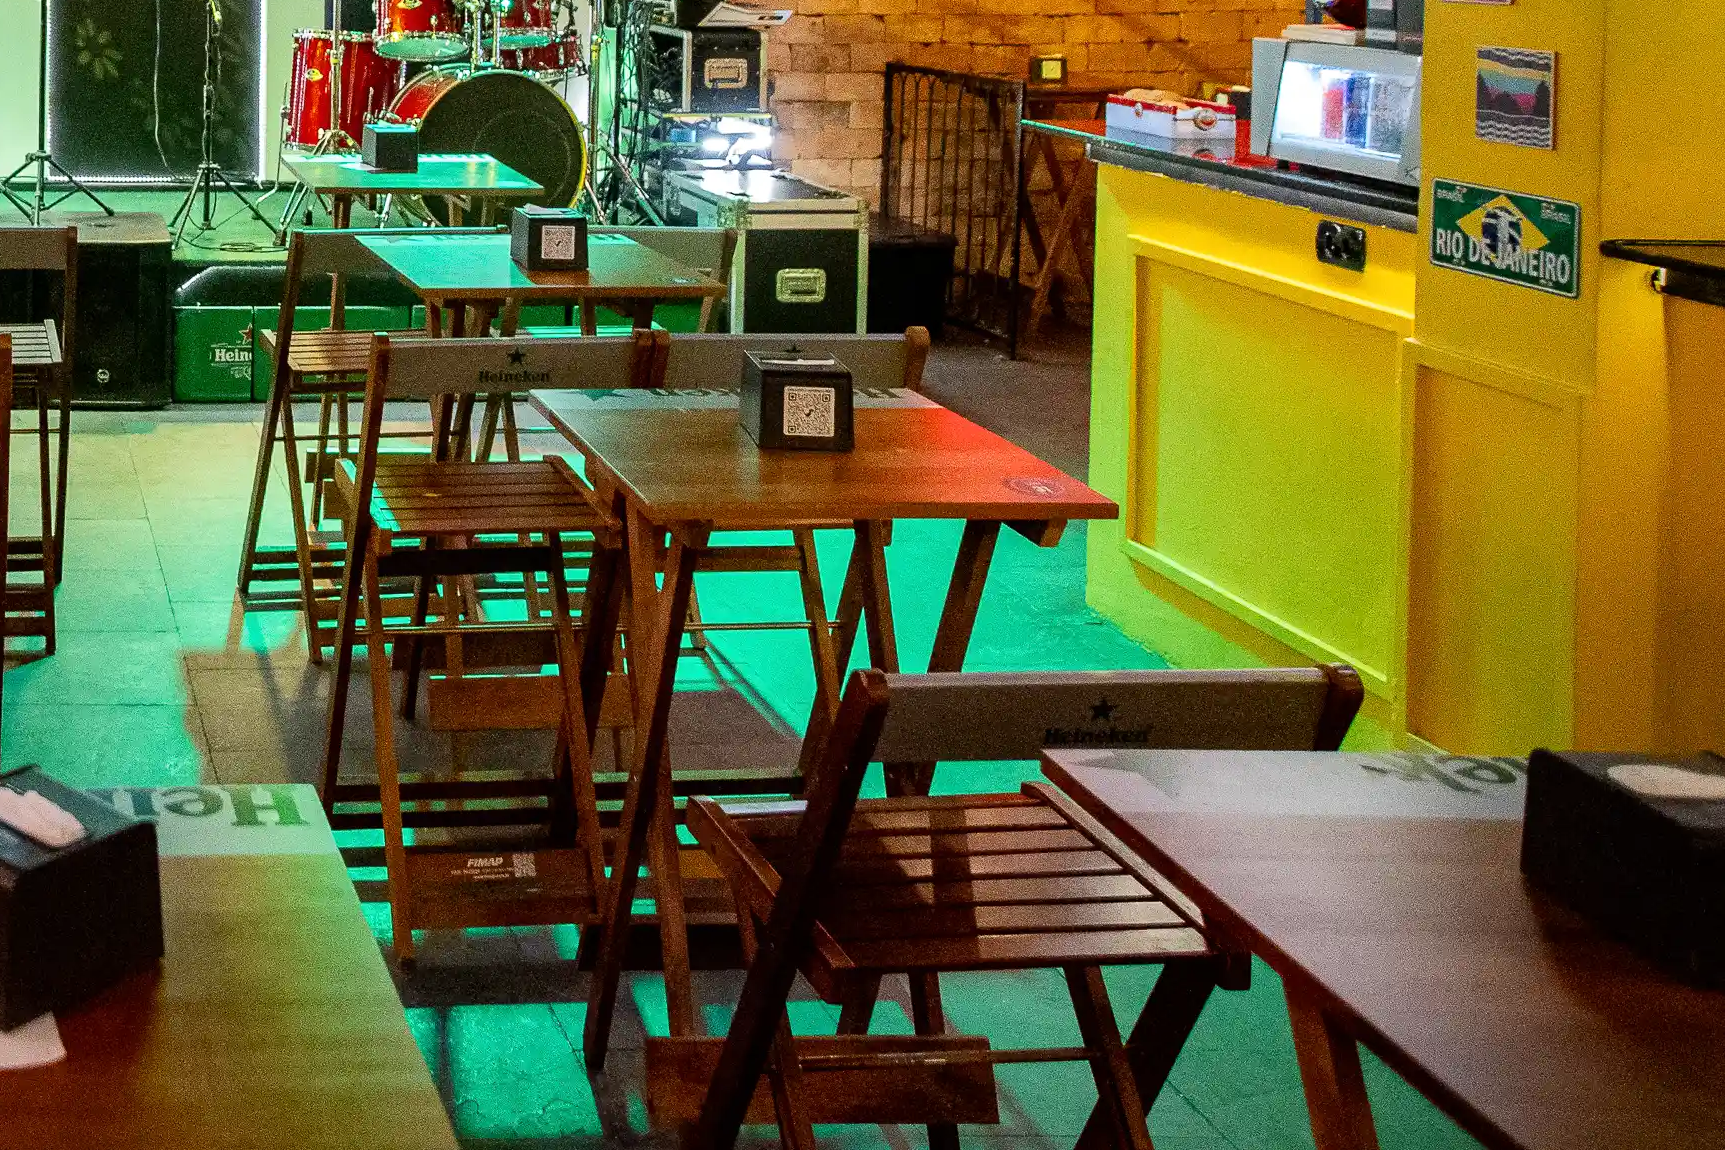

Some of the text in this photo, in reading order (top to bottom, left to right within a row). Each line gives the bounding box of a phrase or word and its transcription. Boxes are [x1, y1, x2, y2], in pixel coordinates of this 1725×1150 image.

[1435, 228, 1572, 284] RIO DE JANEIRO
[478, 369, 551, 384] Heineken
